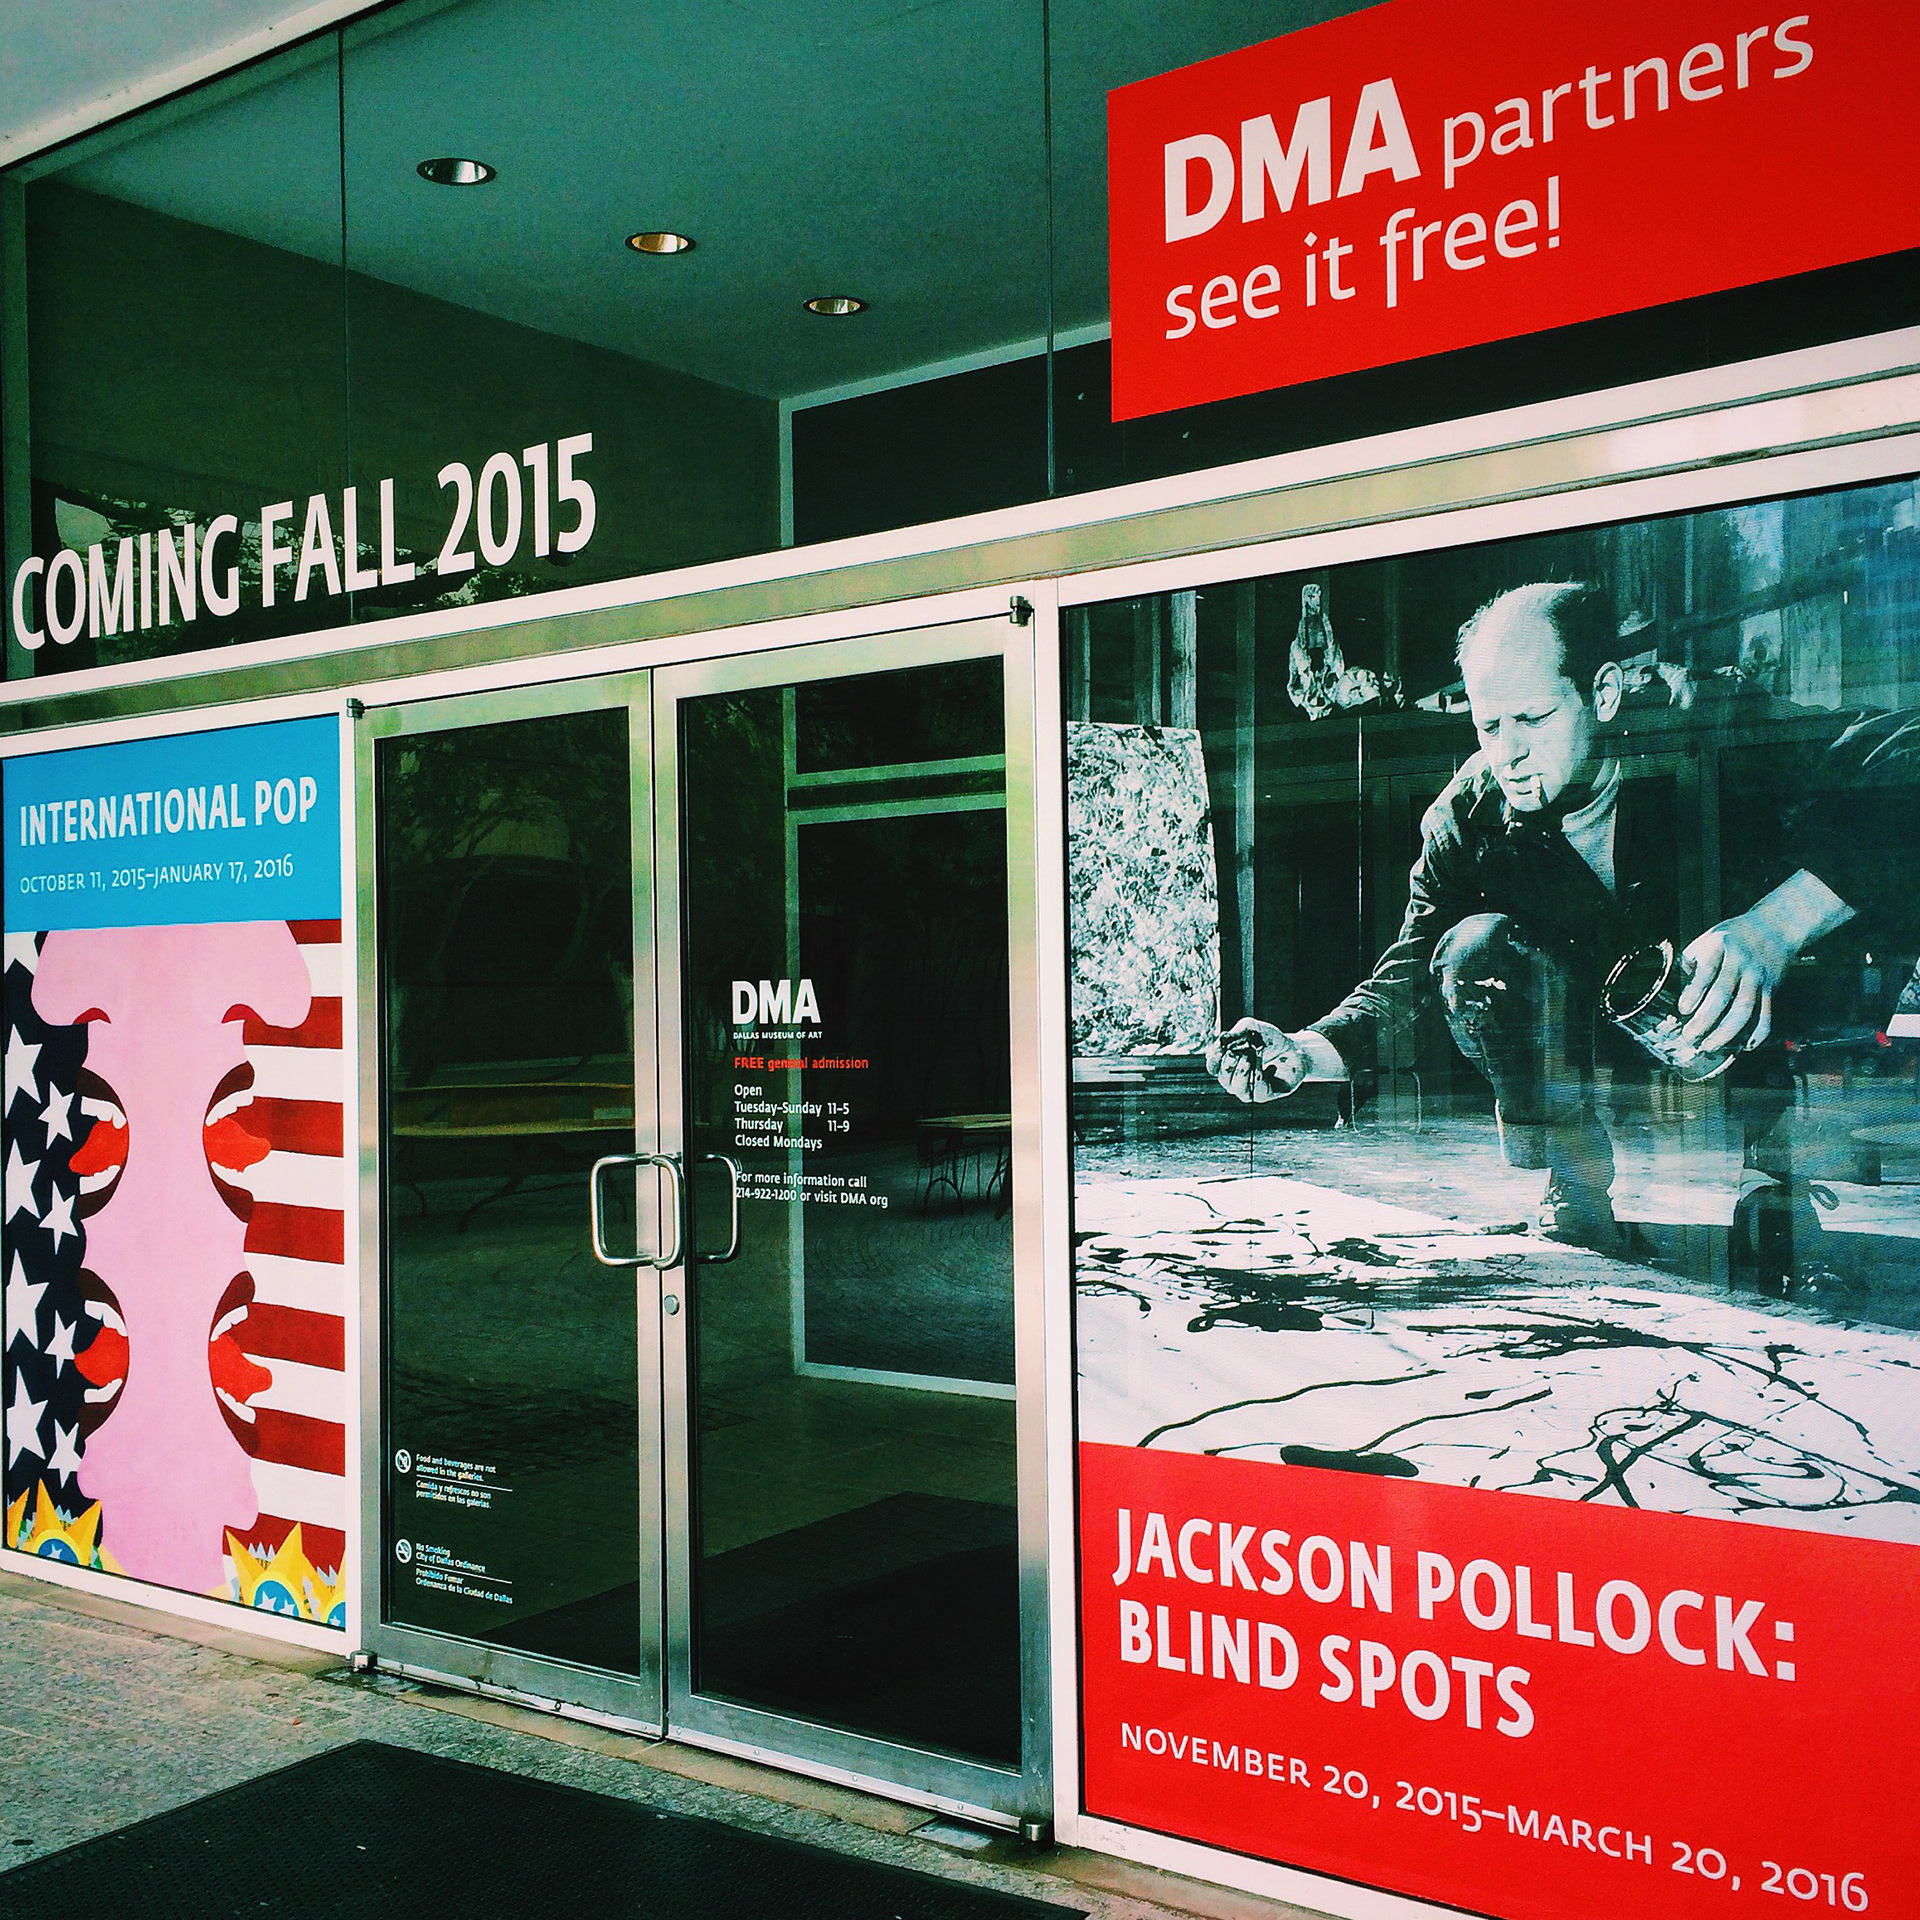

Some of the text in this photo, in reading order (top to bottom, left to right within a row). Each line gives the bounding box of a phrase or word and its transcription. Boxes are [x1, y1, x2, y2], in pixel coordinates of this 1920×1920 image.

[1164, 15, 1814, 244] DMA partners
[1165, 175, 1562, 341] see it free!
[13, 432, 597, 650] COMING FALL 2015
[20, 776, 318, 847] INTERNATIONAL POP
[20, 868, 86, 894] OCTOBER
[89, 871, 106, 893] 11,
[229, 861, 247, 884] 17,
[254, 853, 294, 879] 2016
[732, 978, 822, 1025] DMA
[733, 1031, 823, 1040] DALLAS MUSEUM OF ART
[734, 1056, 869, 1072] FREE general admission
[734, 1084, 763, 1098] Open
[734, 1118, 784, 1132] Thursday
[735, 1134, 823, 1151] Closed Mondays
[736, 1171, 867, 1188] For more information call
[736, 1187, 796, 1201] 214-922-1200
[800, 1192, 811, 1201] or
[814, 1190, 837, 1203] visit
[1113, 1508, 1796, 1682] JACKSON POLLOCK:
[1120, 1598, 1535, 1738] BLIND SPOTS
[1121, 1722, 1311, 1788] NOVEMBER
[1323, 1765, 1381, 1810] 20,
[1672, 1842, 1741, 1892] 20,
[1761, 1860, 1869, 1913] 2016
